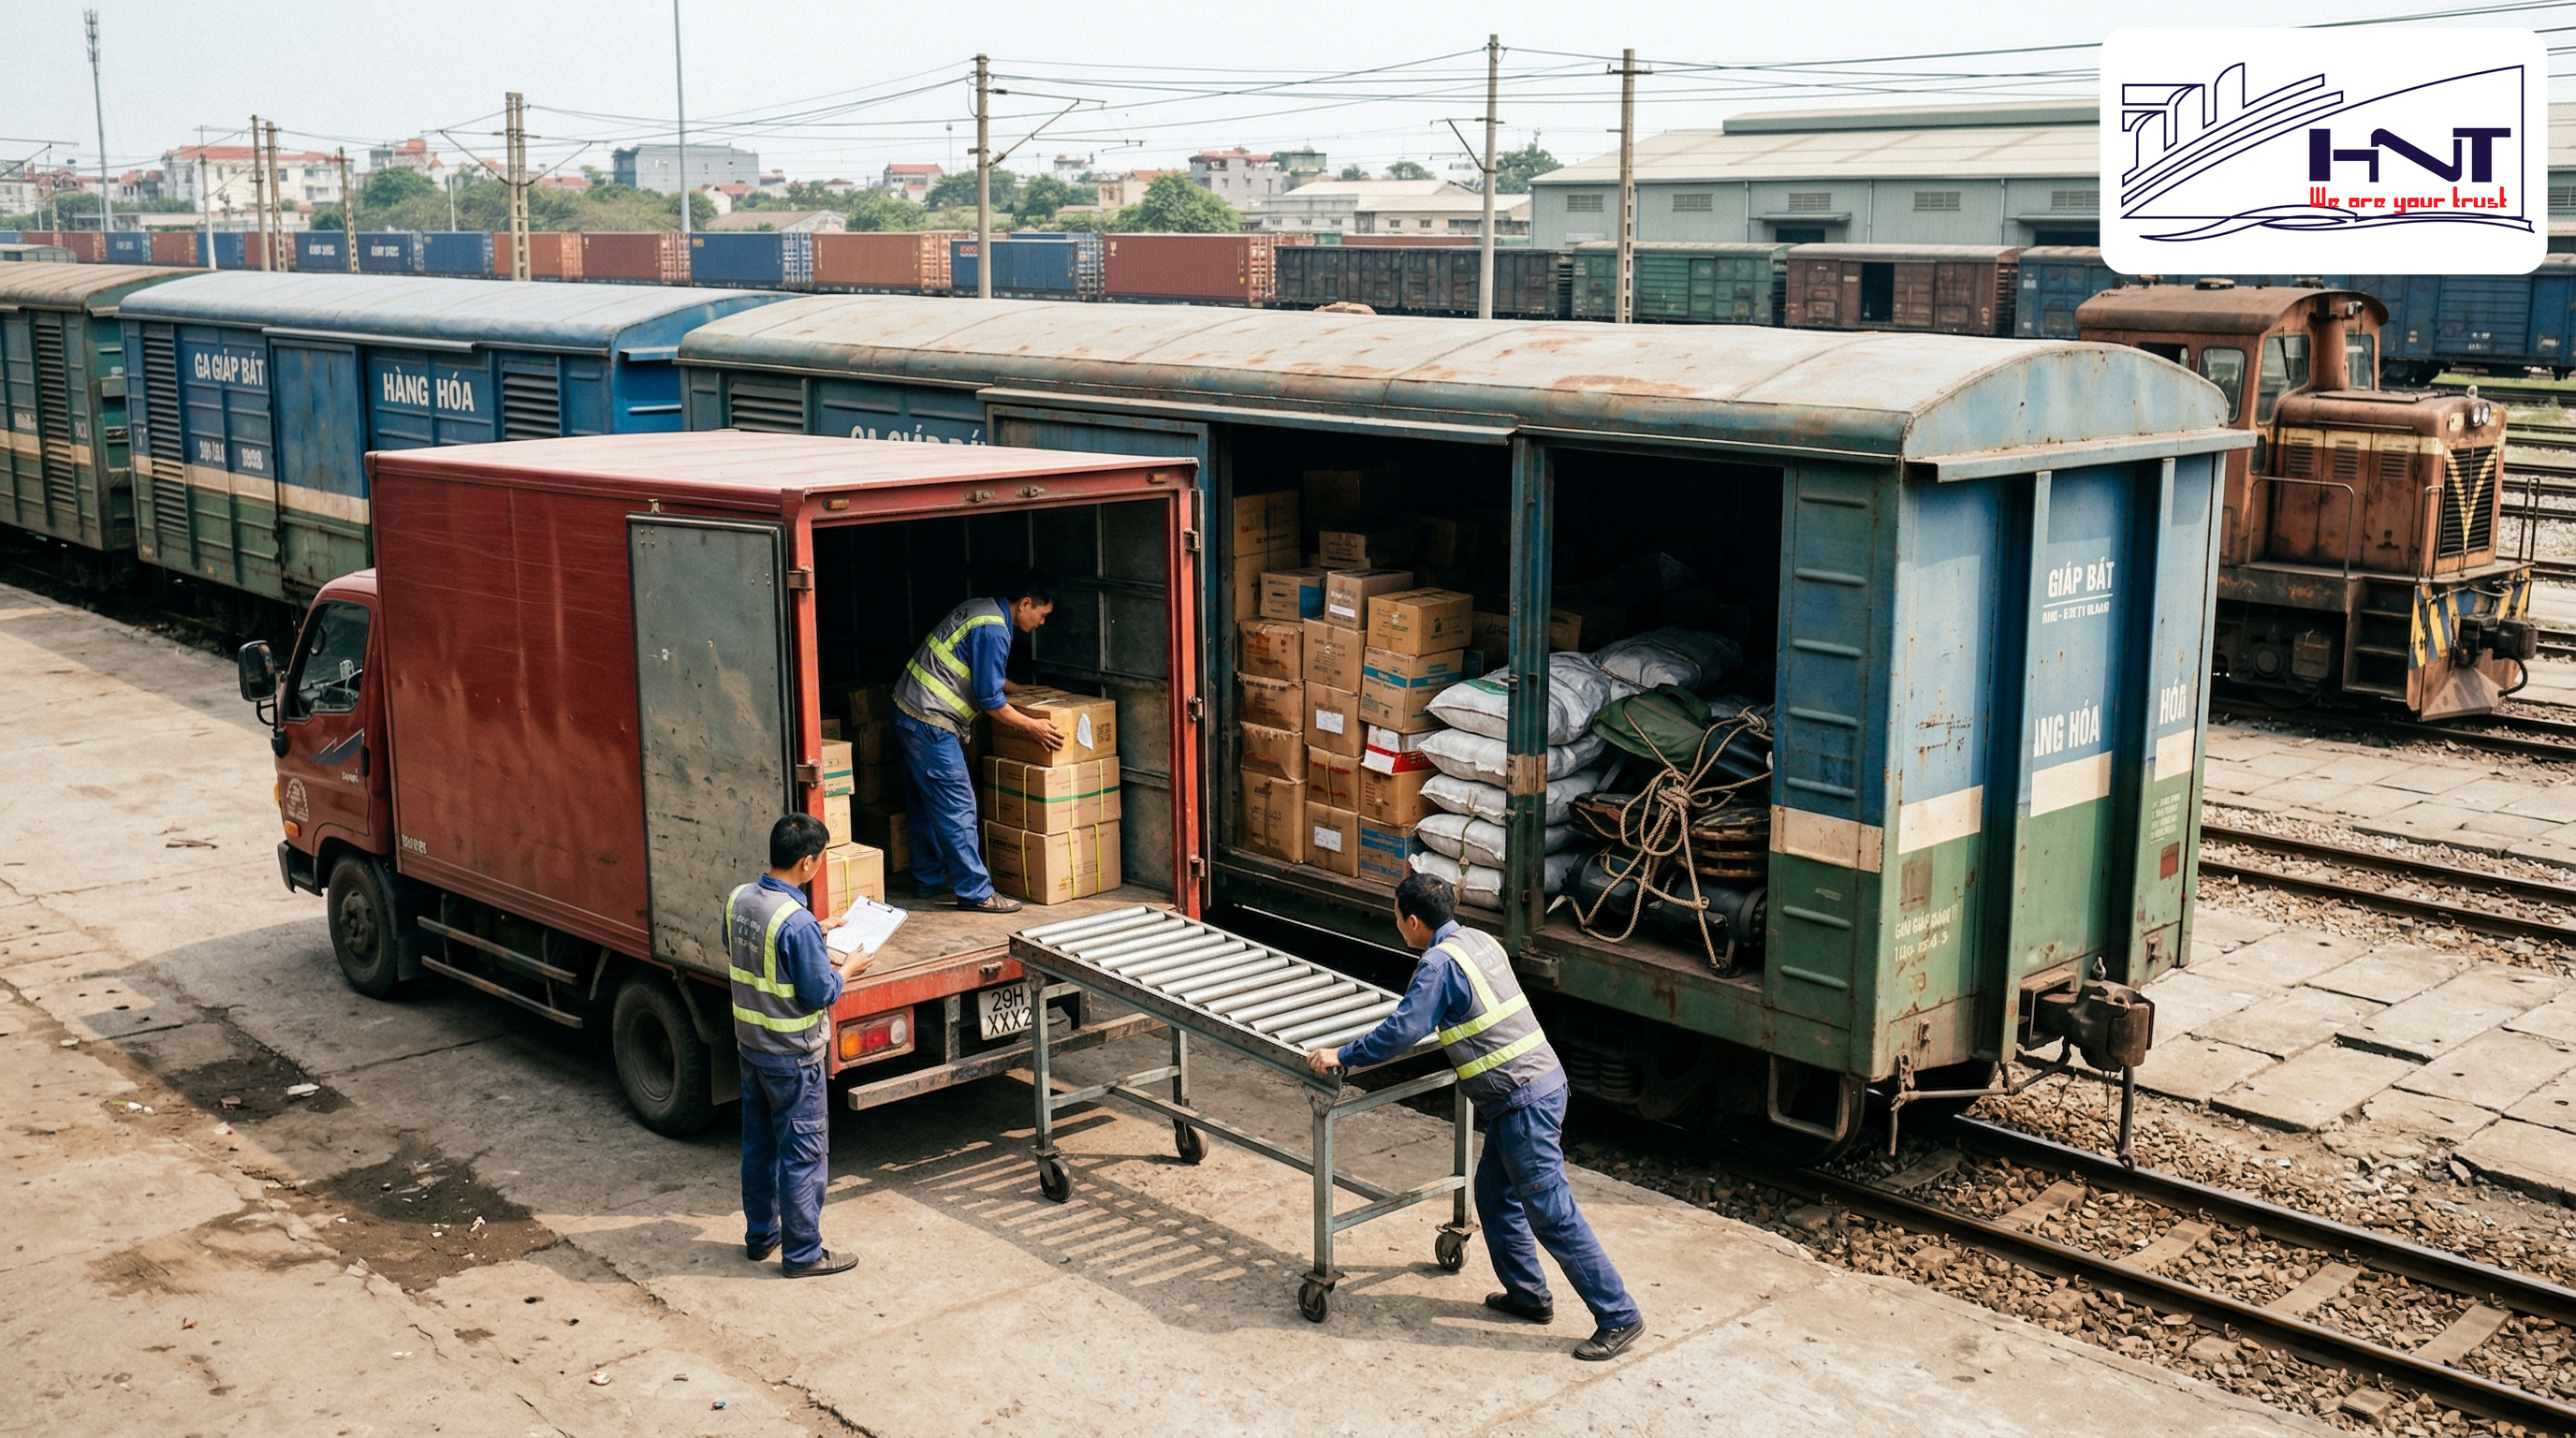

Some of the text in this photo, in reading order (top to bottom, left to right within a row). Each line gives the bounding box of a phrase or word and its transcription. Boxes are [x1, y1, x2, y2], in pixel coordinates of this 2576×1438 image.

[194, 352, 212, 380] GA
[241, 351, 264, 386] BÁT
[383, 366, 475, 412] HÀNG HÓA
[2048, 556, 2115, 598] GIÁP BÁT
[2069, 698, 2100, 749] HÓA
[991, 985, 1024, 1012] 29H
[988, 1006, 1032, 1035] XXX2
